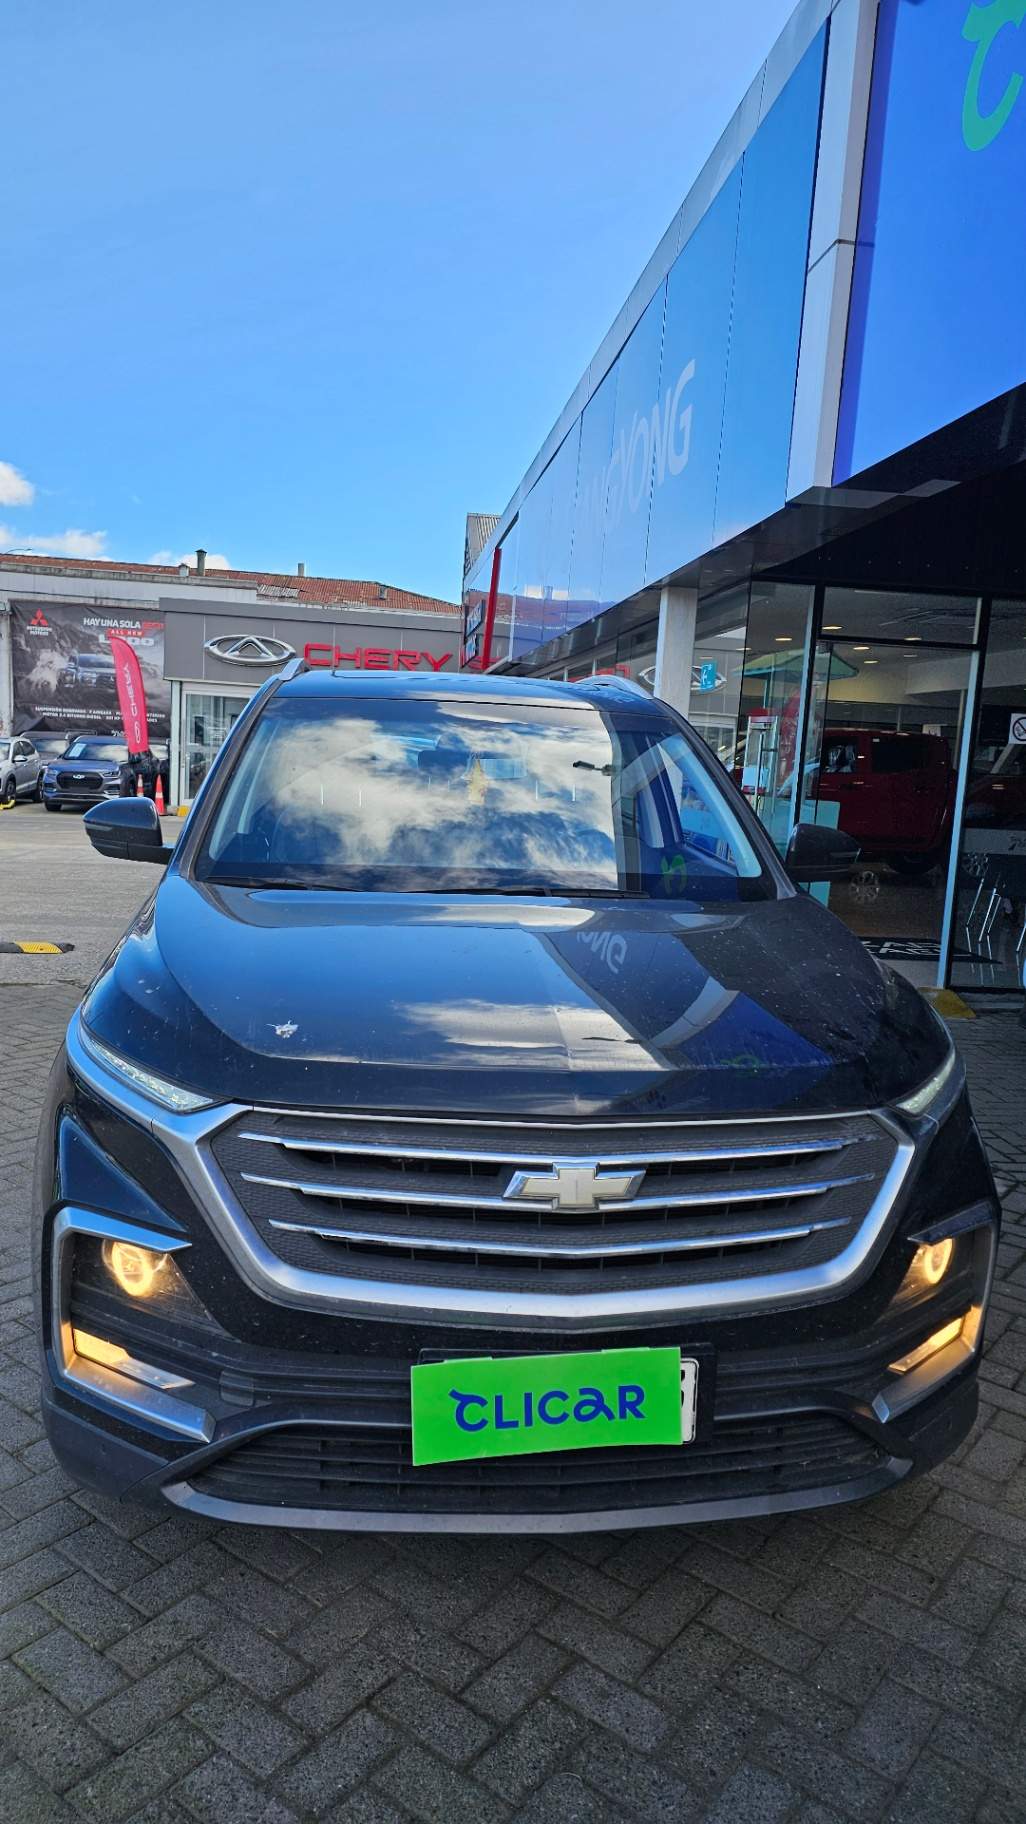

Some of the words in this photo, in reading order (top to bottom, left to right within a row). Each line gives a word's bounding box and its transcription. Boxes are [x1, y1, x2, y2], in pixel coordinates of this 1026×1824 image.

[83, 617, 100, 626] HAY
[101, 618, 119, 628] UNA
[119, 620, 141, 629] SOLA
[98, 633, 154, 646] L00
[304, 643, 452, 671] CHERY
